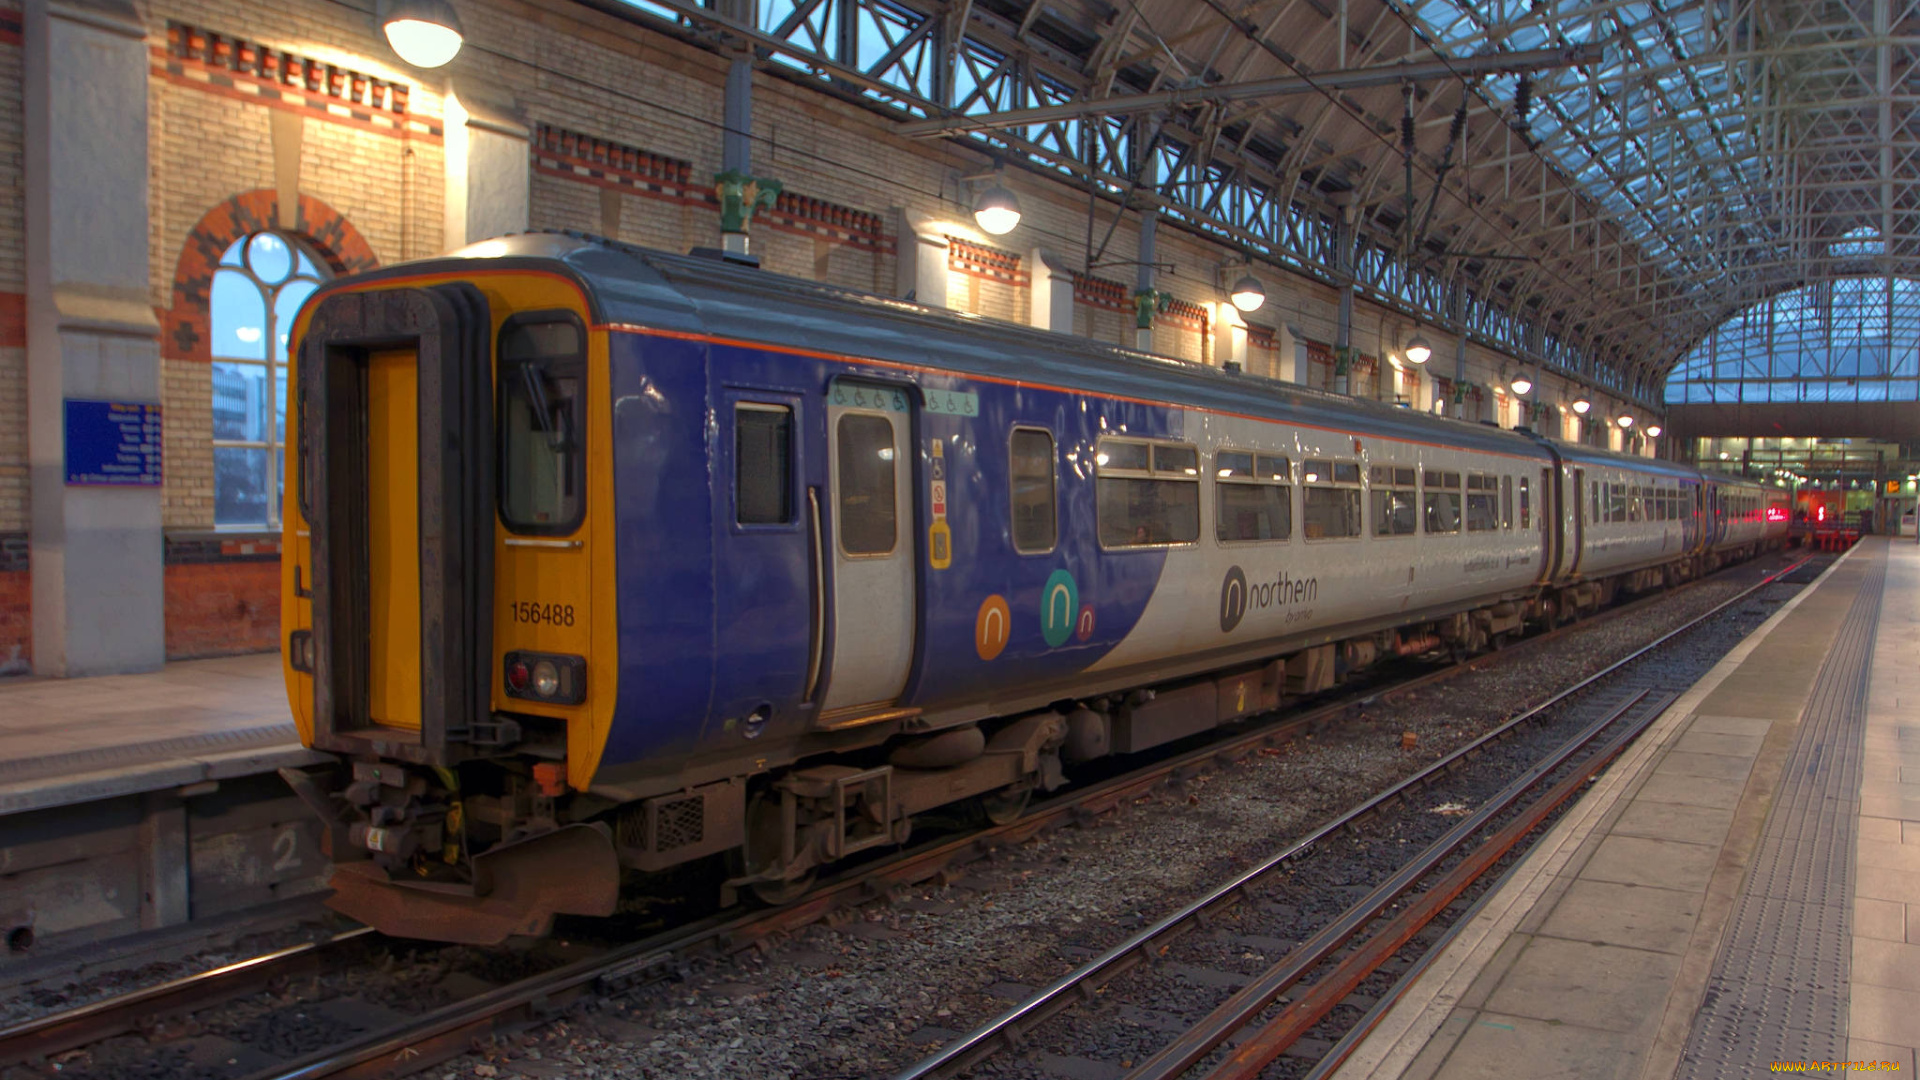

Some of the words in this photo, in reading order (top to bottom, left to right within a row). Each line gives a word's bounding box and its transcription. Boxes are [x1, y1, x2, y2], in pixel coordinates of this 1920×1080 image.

[1250, 571, 1318, 609] northern
[511, 601, 575, 627] 156488
[272, 828, 302, 871] 2
